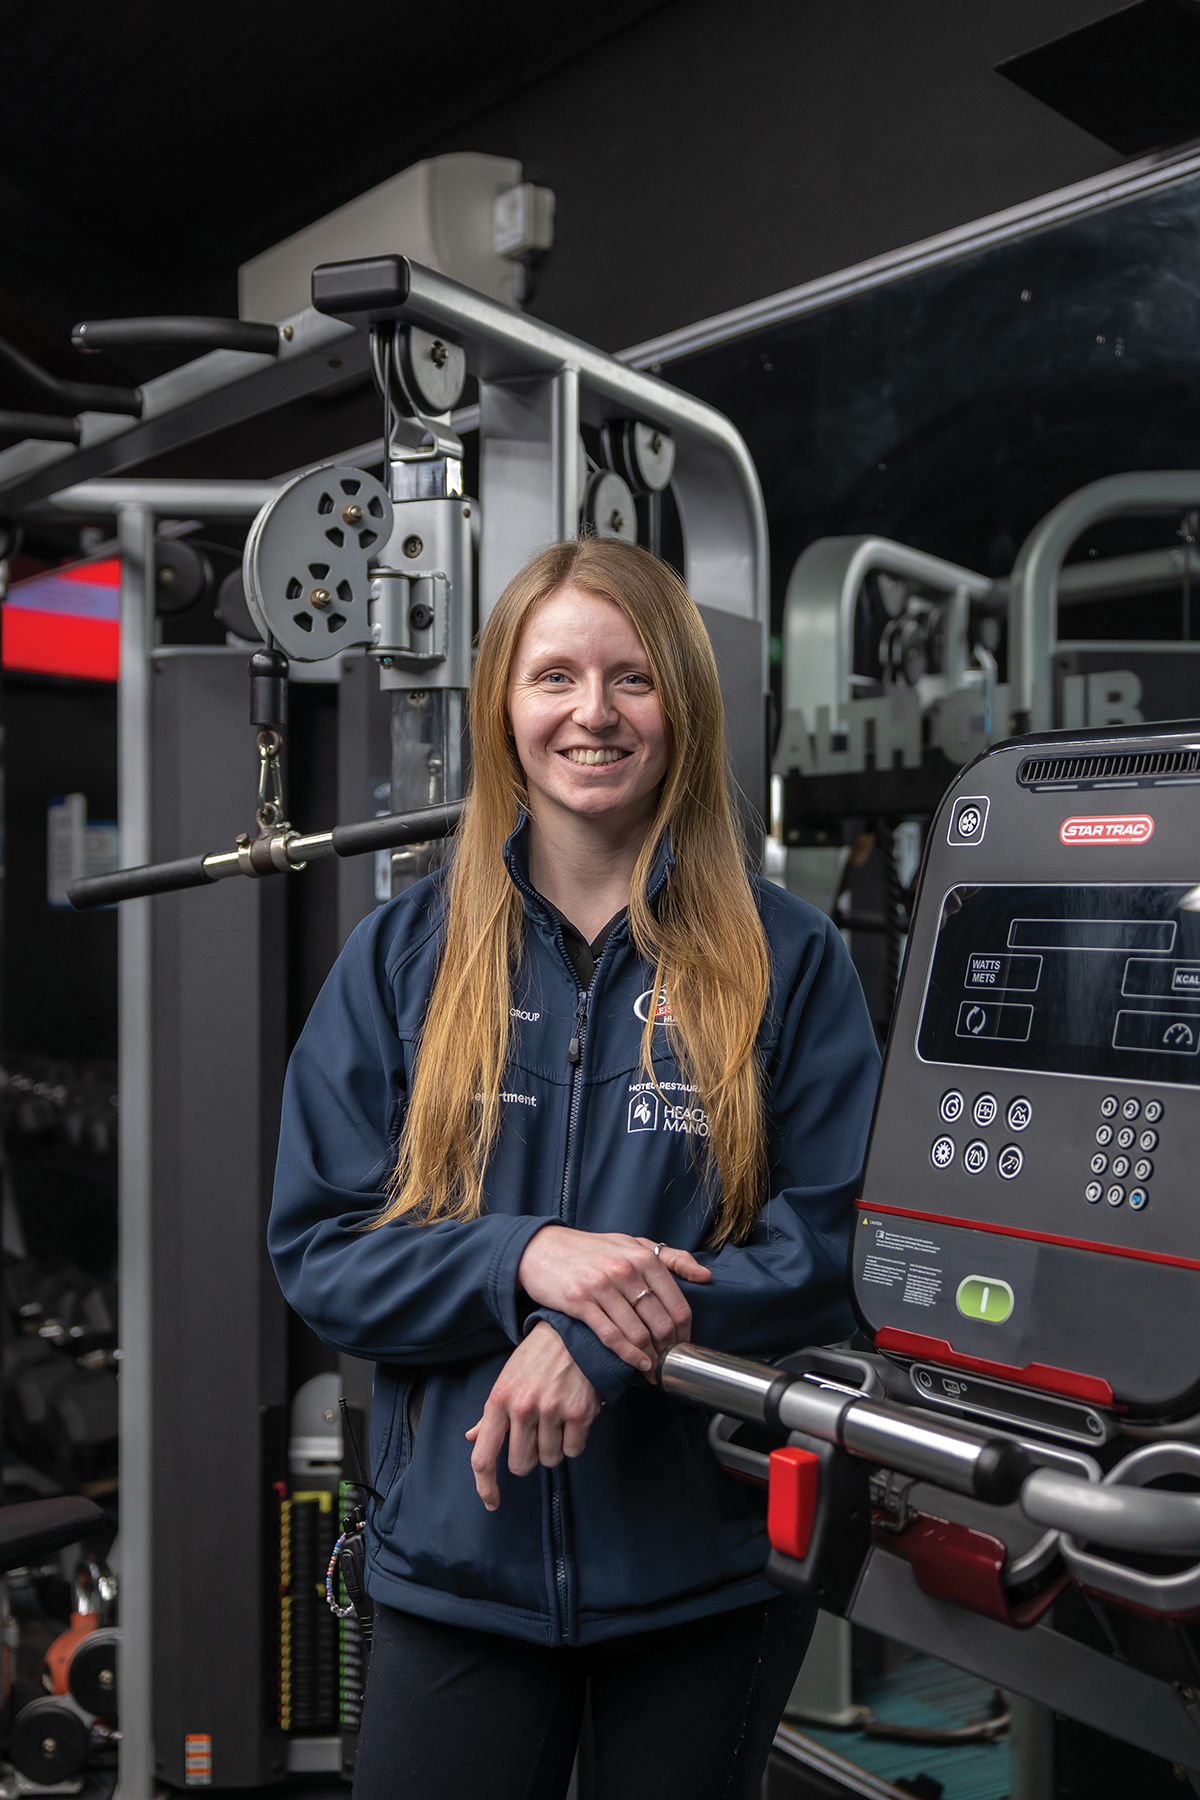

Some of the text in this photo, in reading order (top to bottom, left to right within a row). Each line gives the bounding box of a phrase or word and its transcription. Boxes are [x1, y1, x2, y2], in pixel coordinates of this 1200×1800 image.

[1065, 824, 1145, 836] STAR TRAC
[972, 959, 1001, 970] WATTS
[972, 972, 996, 984] METS
[1176, 974, 1200, 985] KCAL
[509, 1007, 540, 1022] GROUP
[628, 1082, 656, 1092] HOTEL
[664, 1105, 711, 1123] HEACH
[663, 1118, 713, 1137] MANO
